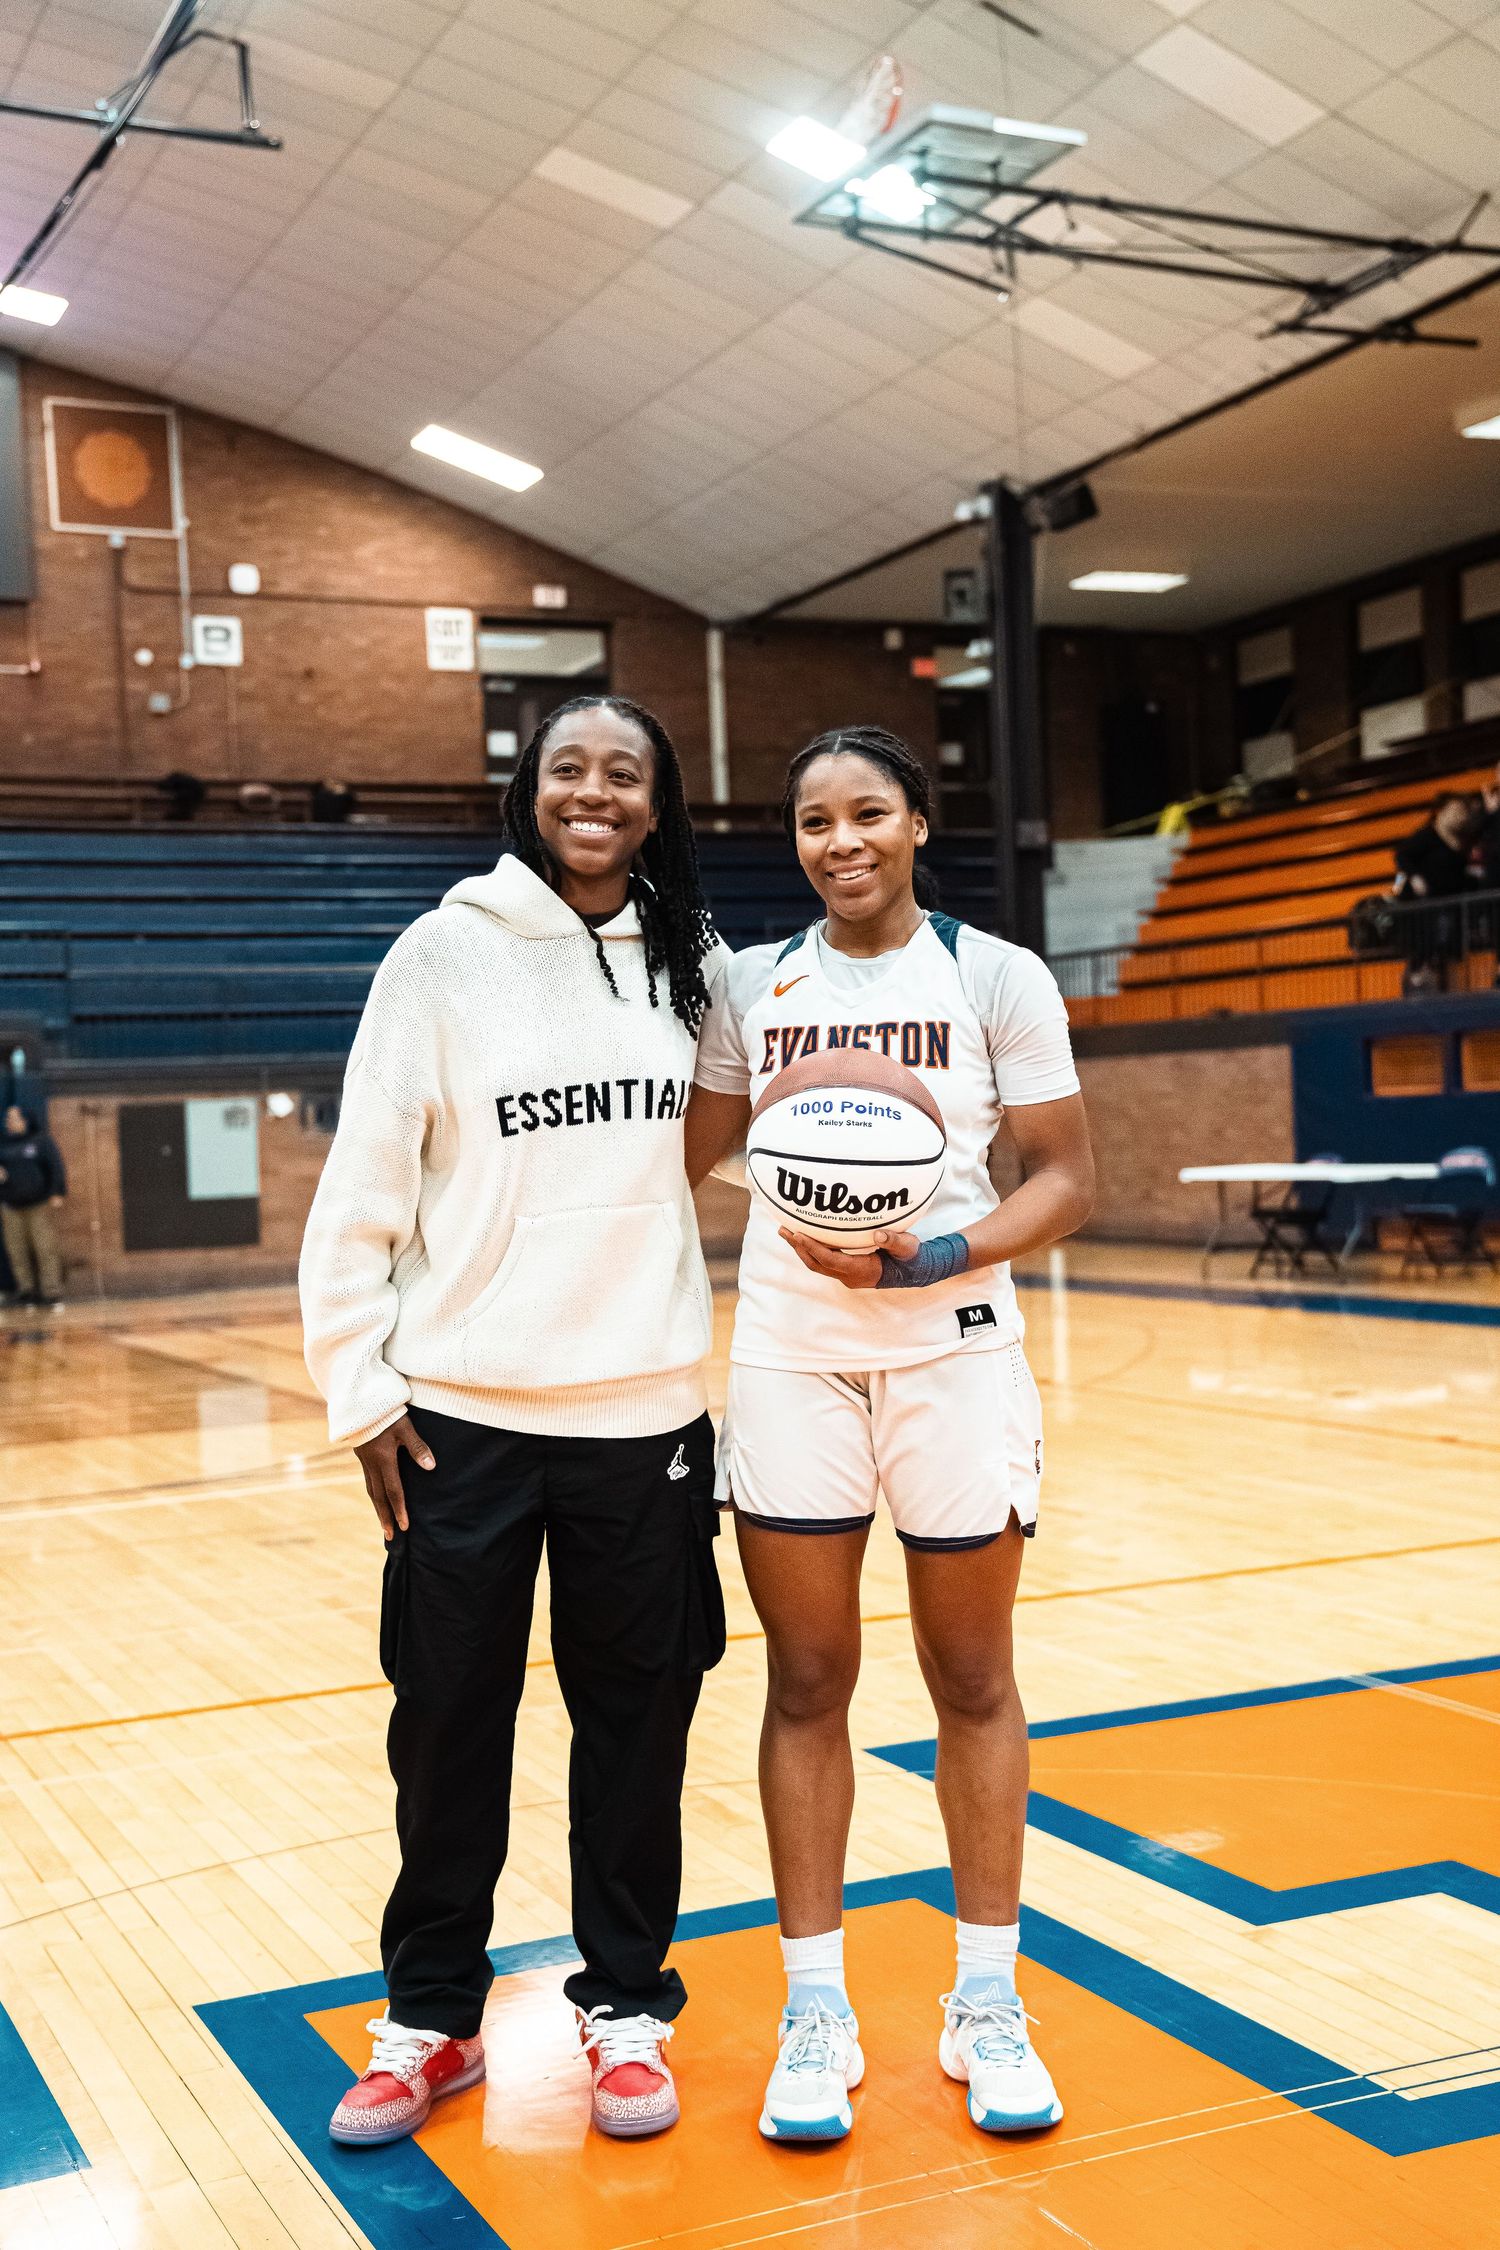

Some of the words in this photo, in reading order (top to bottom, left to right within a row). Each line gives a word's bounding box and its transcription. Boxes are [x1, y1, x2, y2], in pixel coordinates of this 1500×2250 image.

[495, 1078, 692, 1138] ESSENTIAL
[790, 1101, 833, 1117] 1000
[841, 1101, 902, 1121] Points
[846, 1119, 873, 1128] Starks
[776, 1166, 909, 1215] Wilson
[795, 1207, 837, 1221] AUTOGRAPH
[838, 1214, 883, 1222] BASKETBALL
[968, 1309, 984, 1322] M
